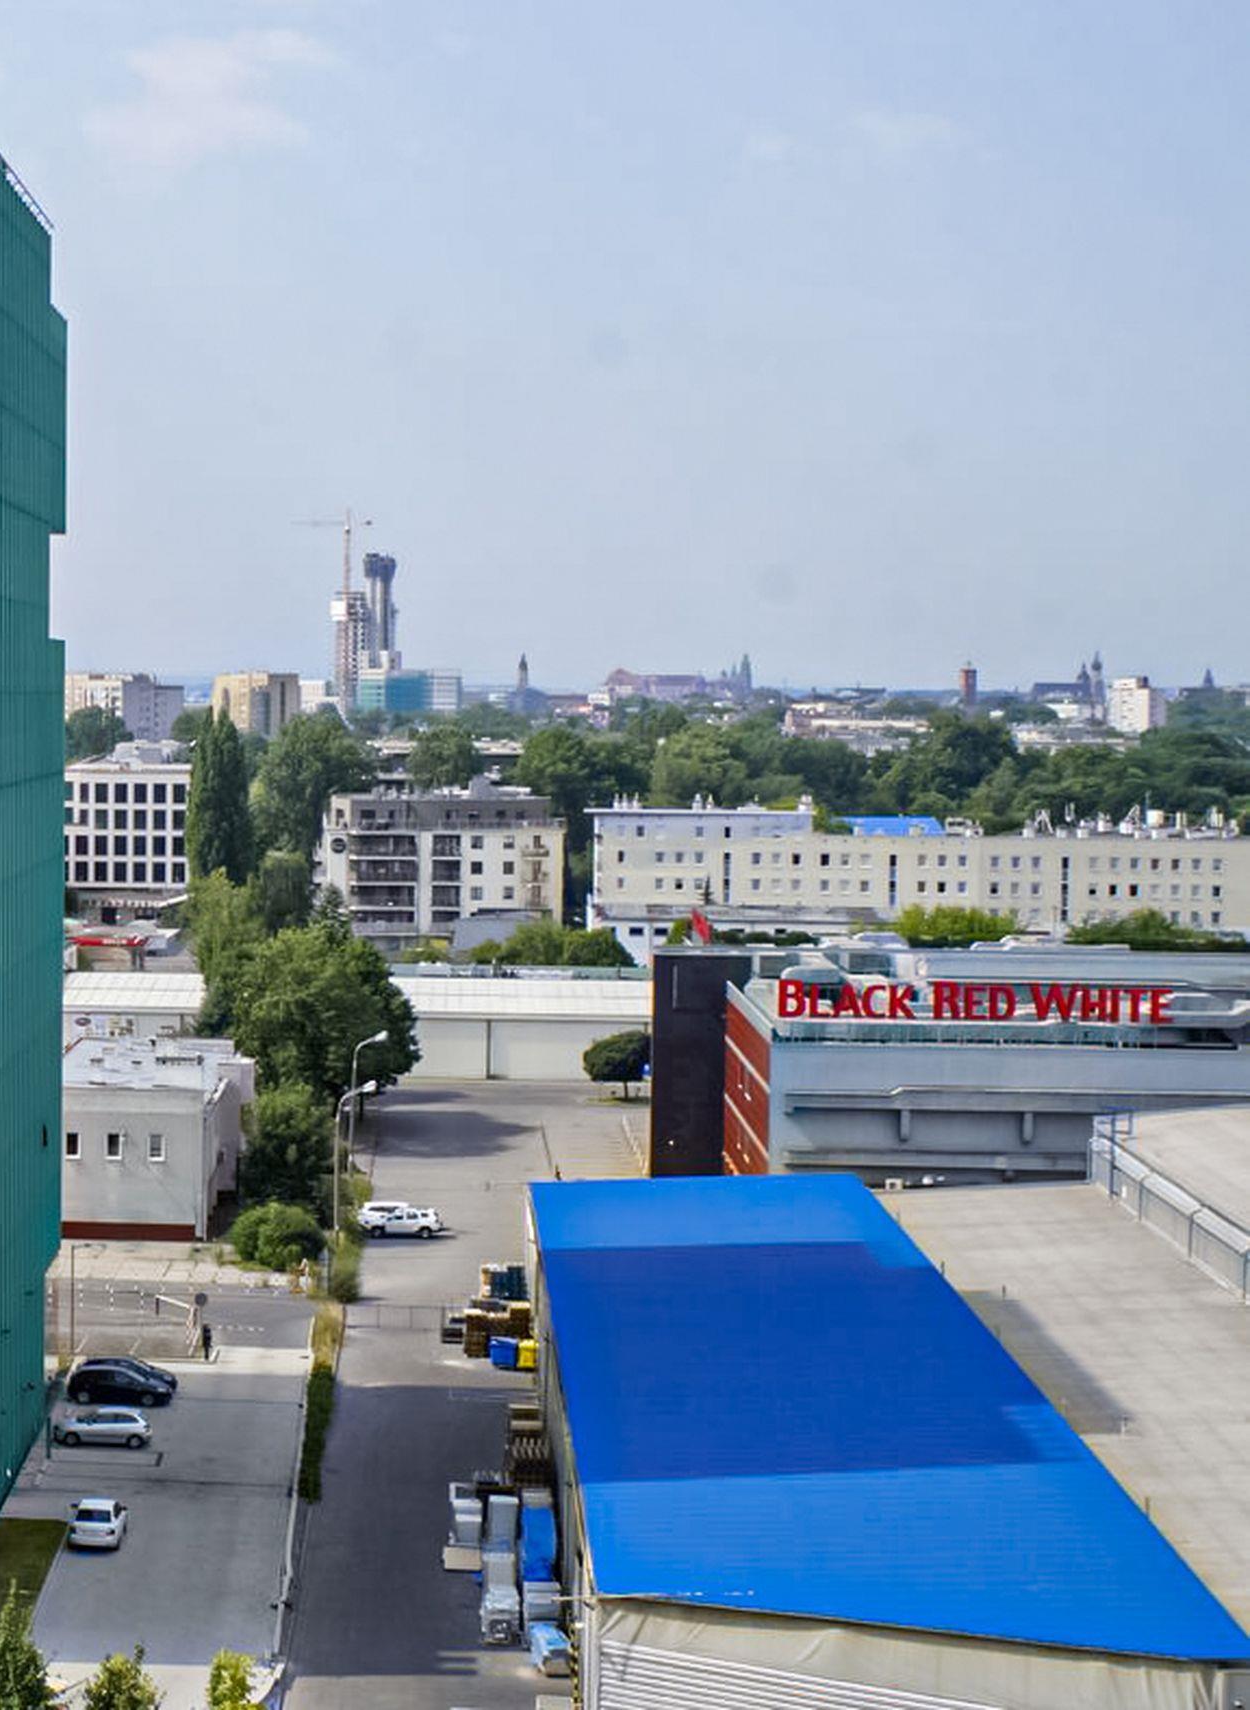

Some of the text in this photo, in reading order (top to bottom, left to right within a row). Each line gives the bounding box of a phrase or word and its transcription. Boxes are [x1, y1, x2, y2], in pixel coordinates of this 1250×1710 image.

[777, 979, 1174, 1024] BLACK RED WHITE
